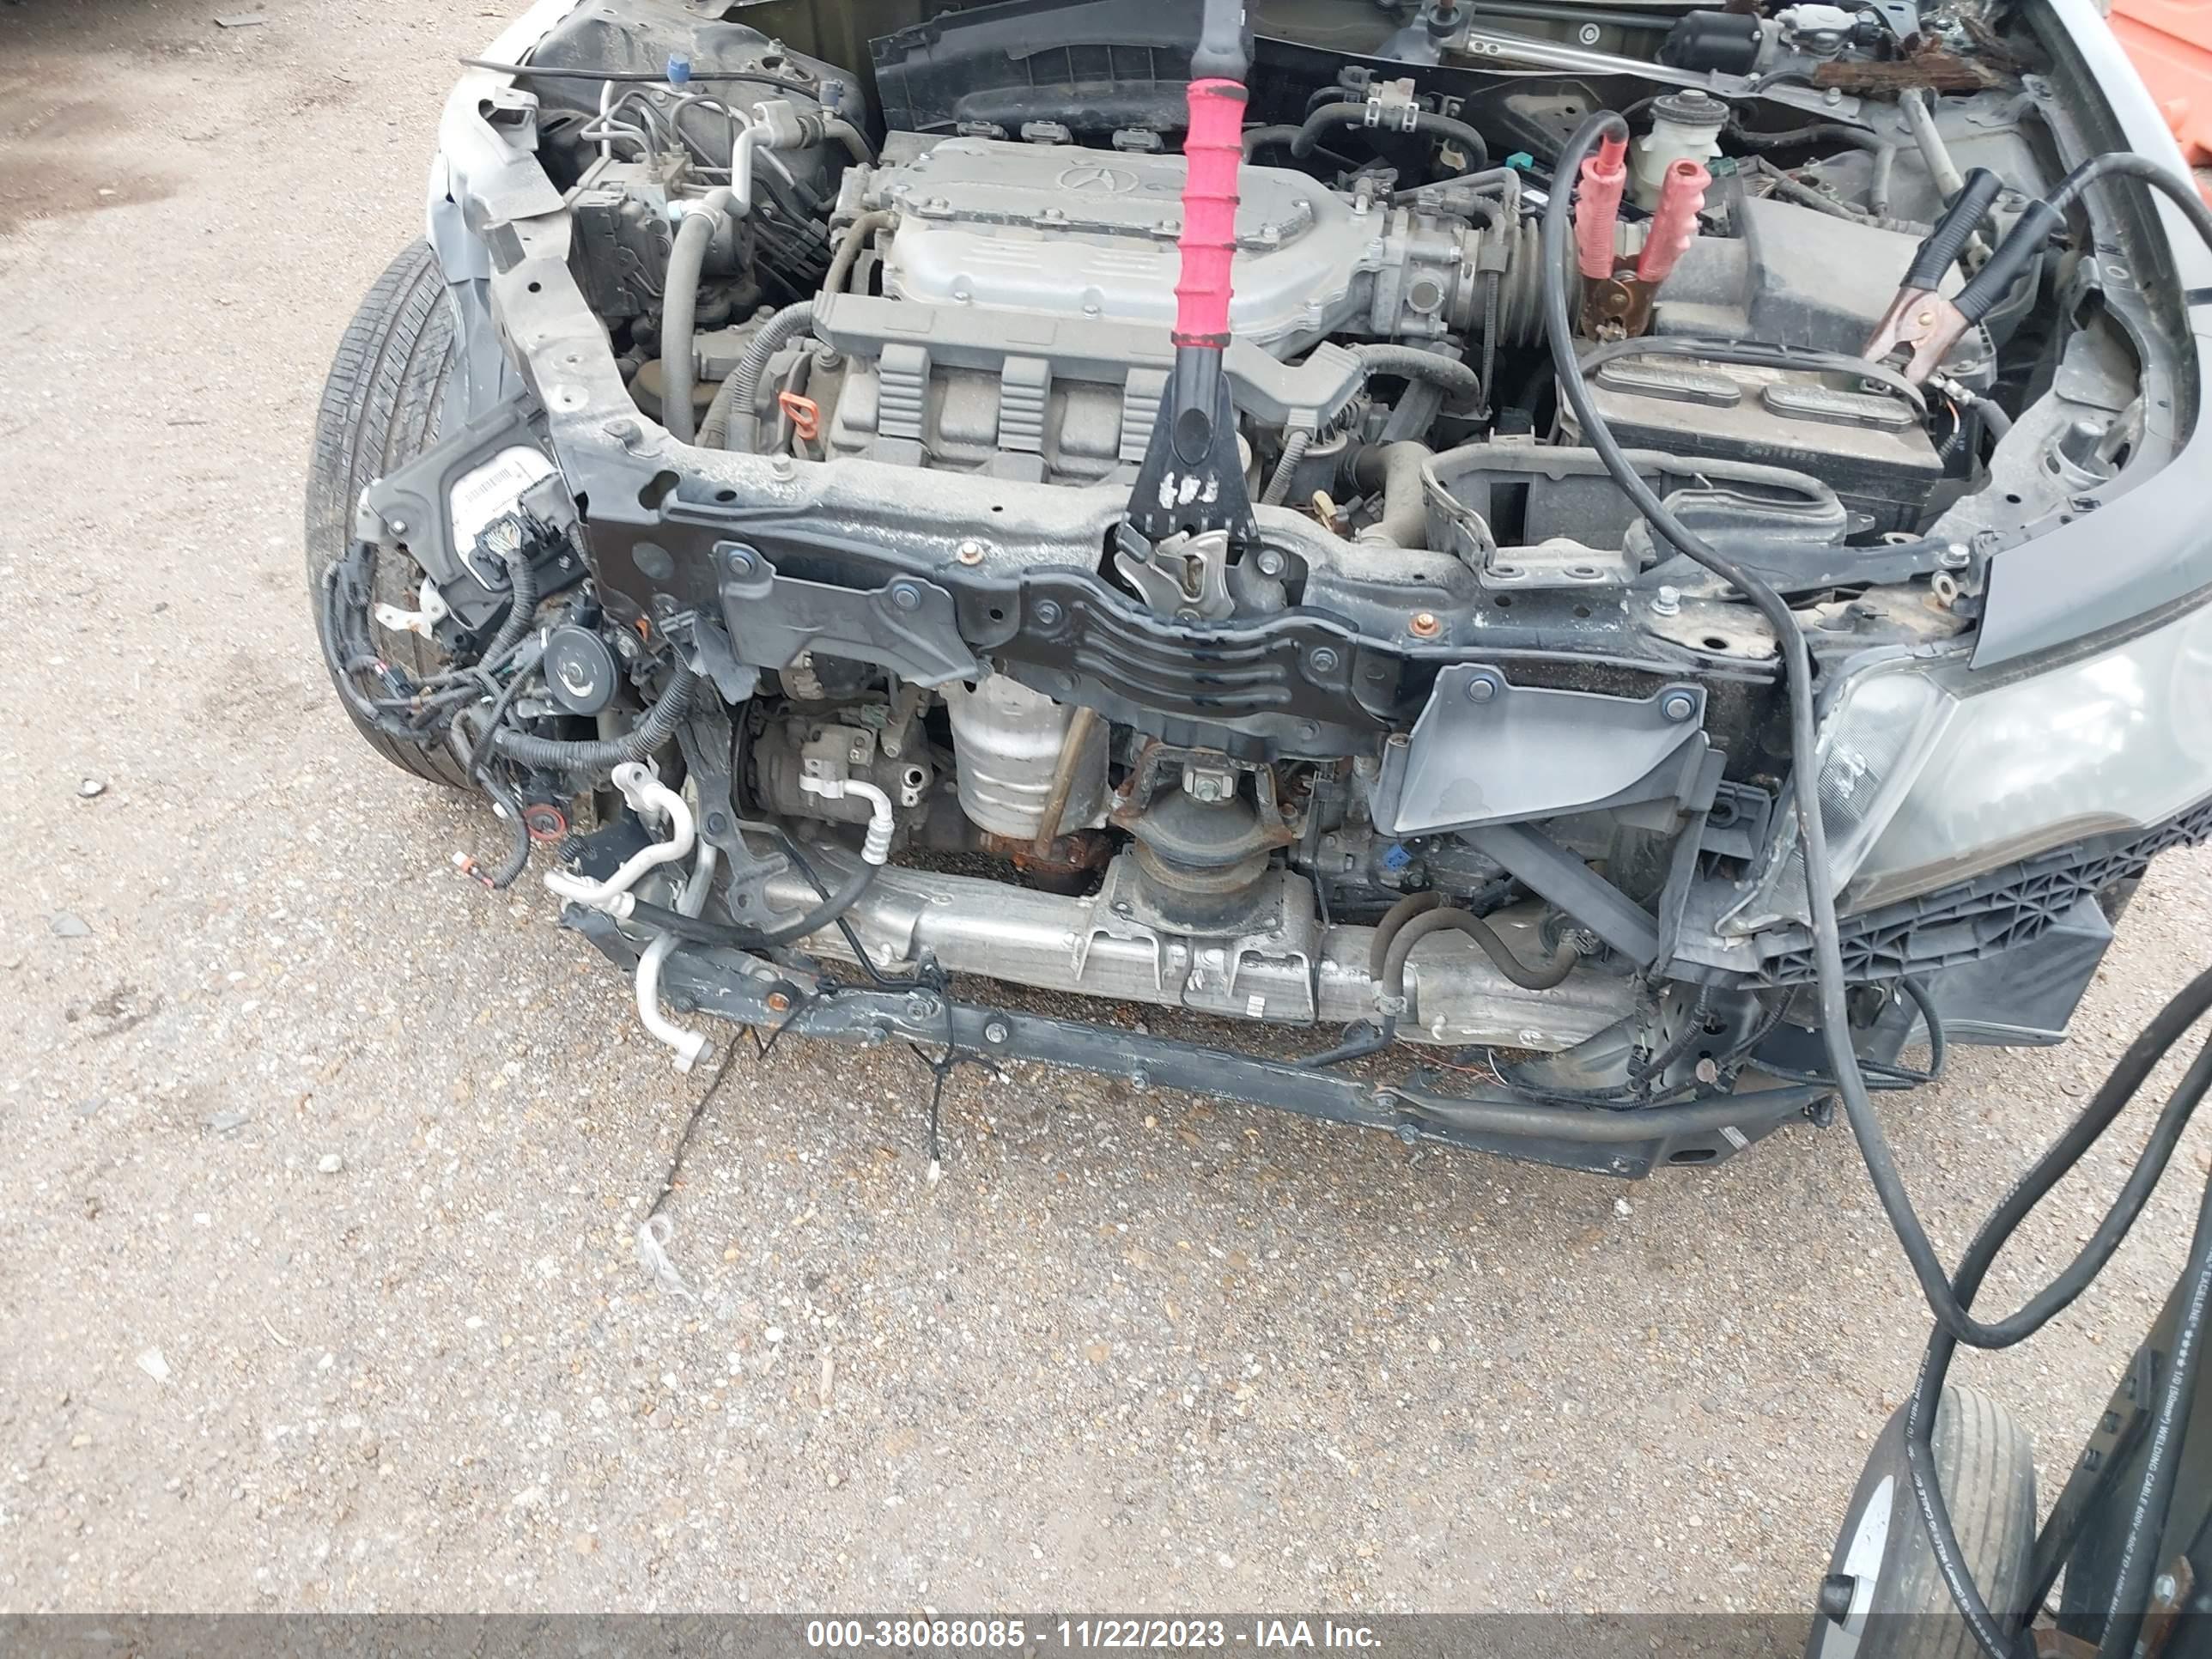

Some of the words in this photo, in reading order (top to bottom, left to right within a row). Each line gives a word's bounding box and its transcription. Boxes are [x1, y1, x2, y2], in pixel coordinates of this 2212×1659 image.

[2148, 1425, 2170, 1472] WELDING
[1917, 1488, 1934, 1520] CABLE
[2139, 1472, 2156, 1508] CABLE
[2122, 1553, 2131, 1569] TO
